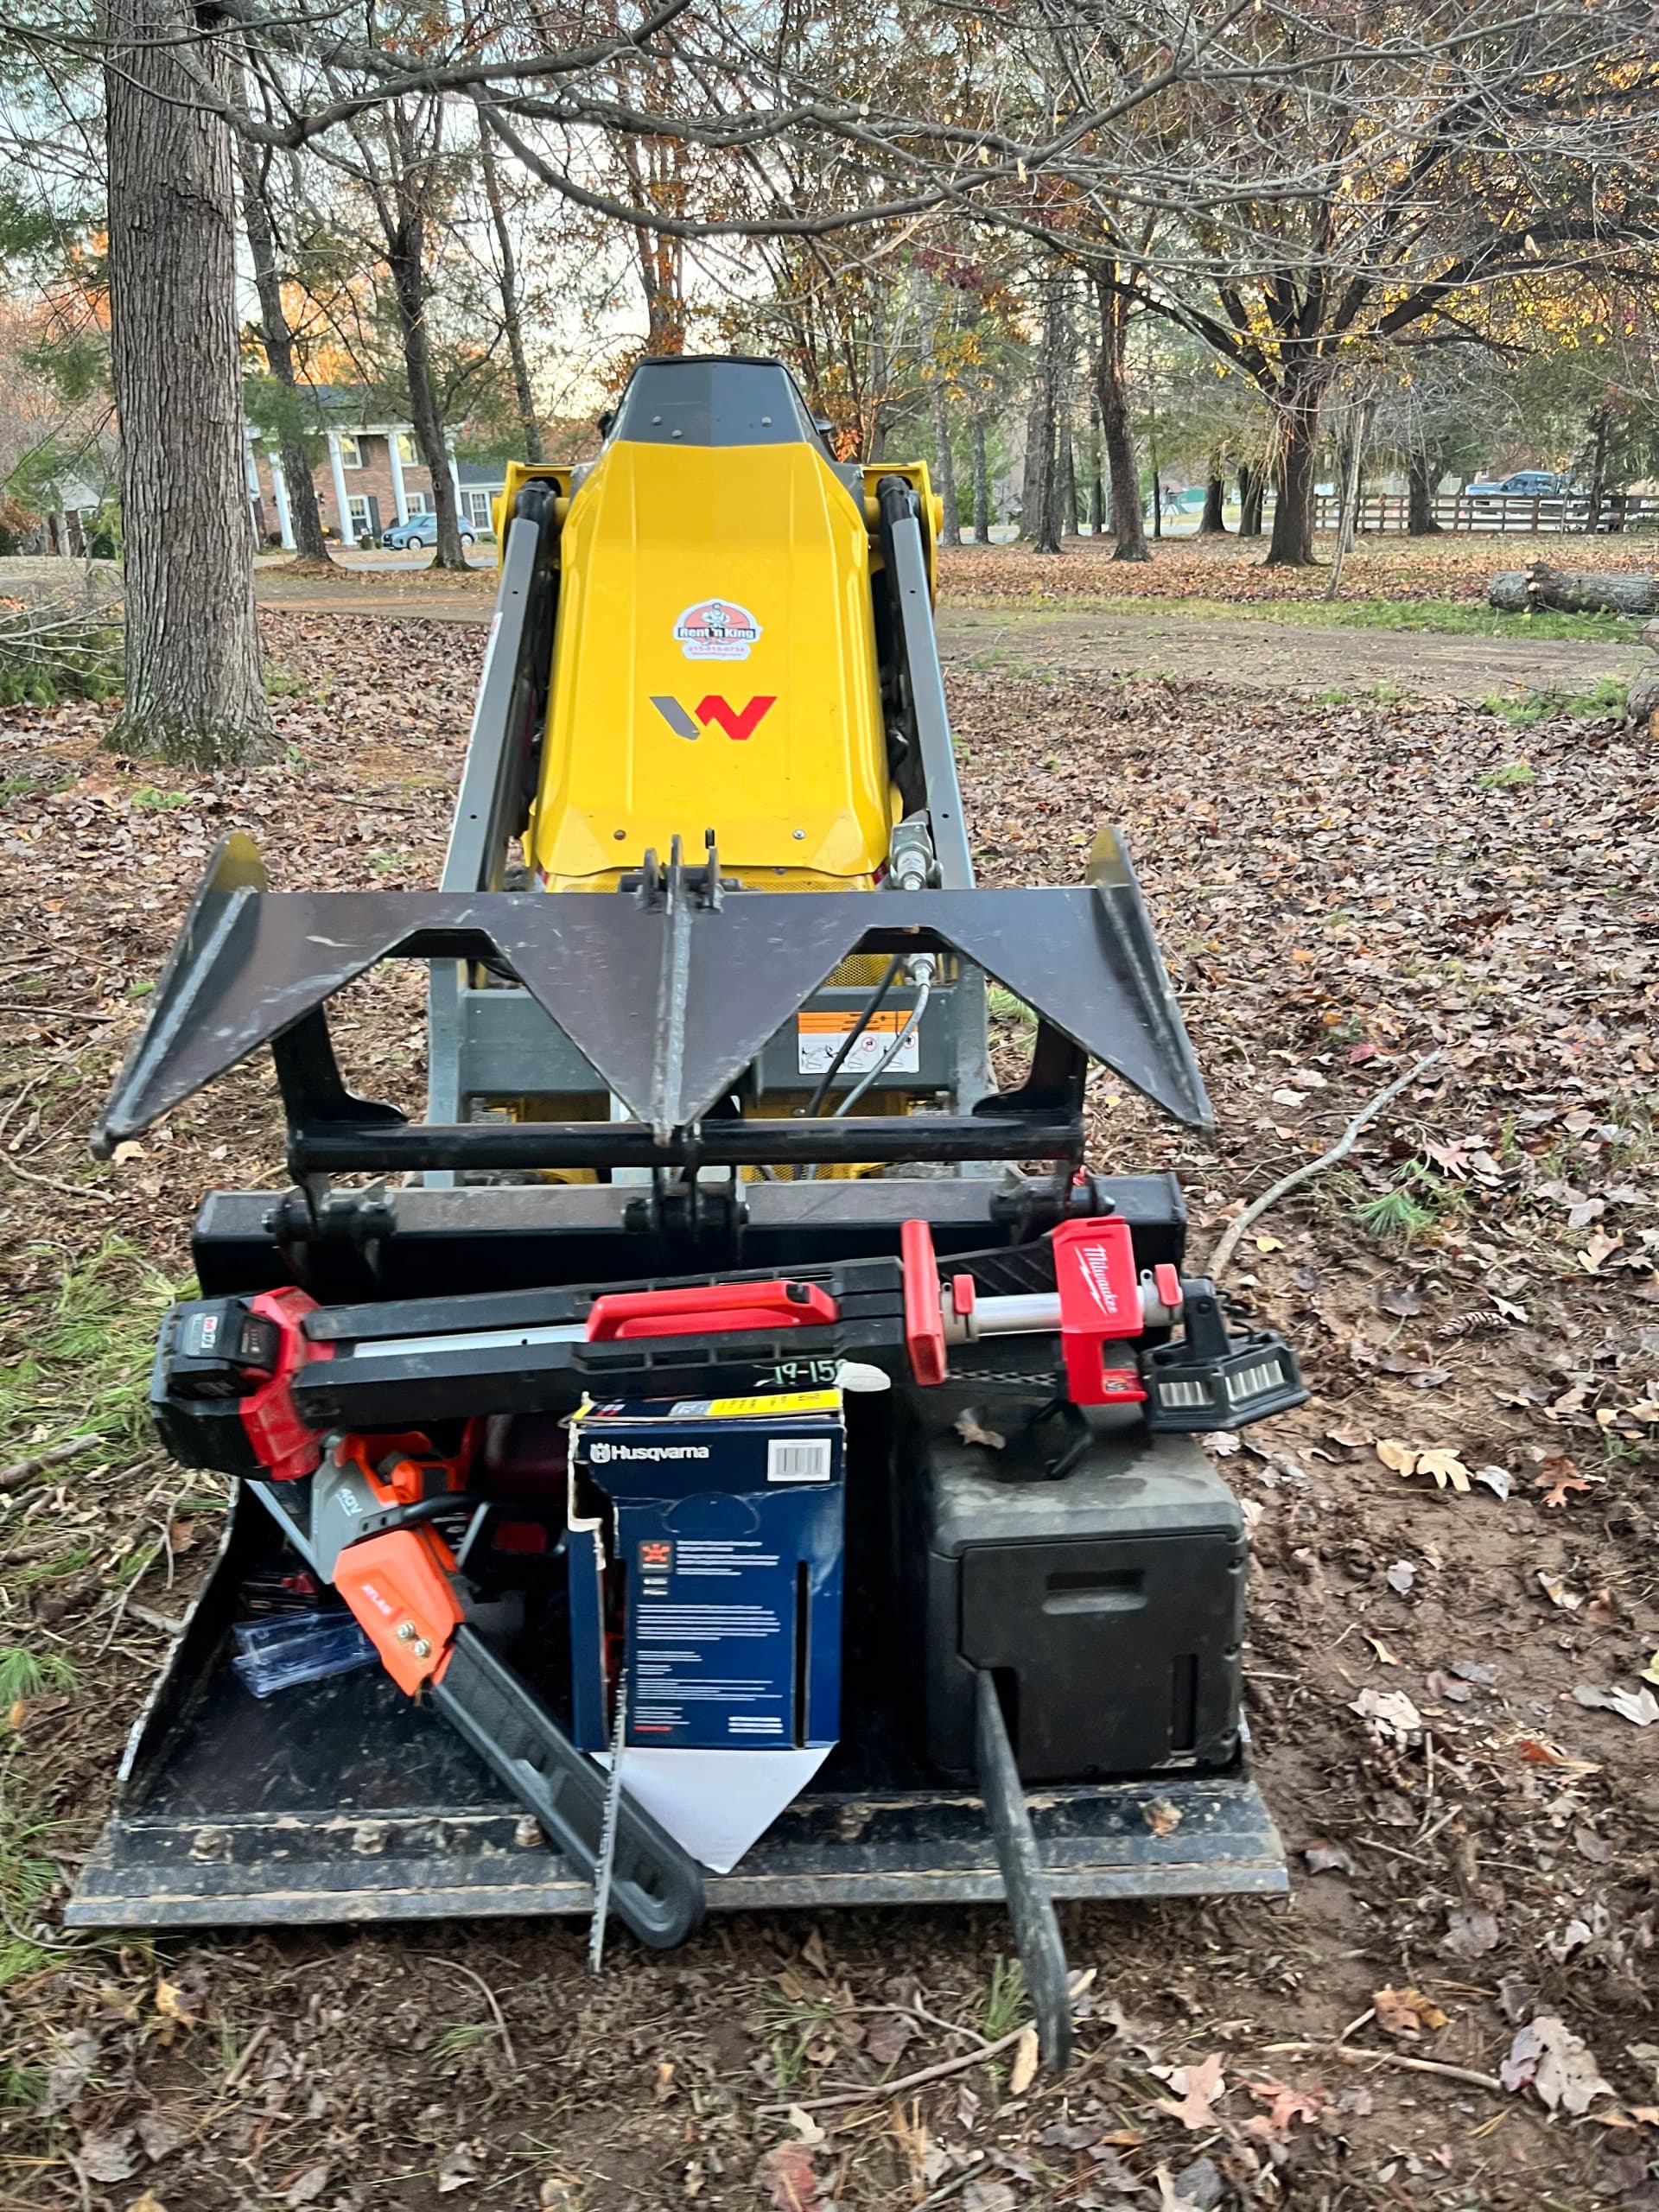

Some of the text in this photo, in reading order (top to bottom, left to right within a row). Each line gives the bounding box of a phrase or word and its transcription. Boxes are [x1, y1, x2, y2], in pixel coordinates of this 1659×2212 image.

[680, 627, 709, 637] Rent
[725, 628, 754, 639] King
[1083, 1243, 1119, 1313] Milwaukee
[611, 1444, 710, 1462] Husqvarna
[359, 1583, 394, 1617] ATLAS
